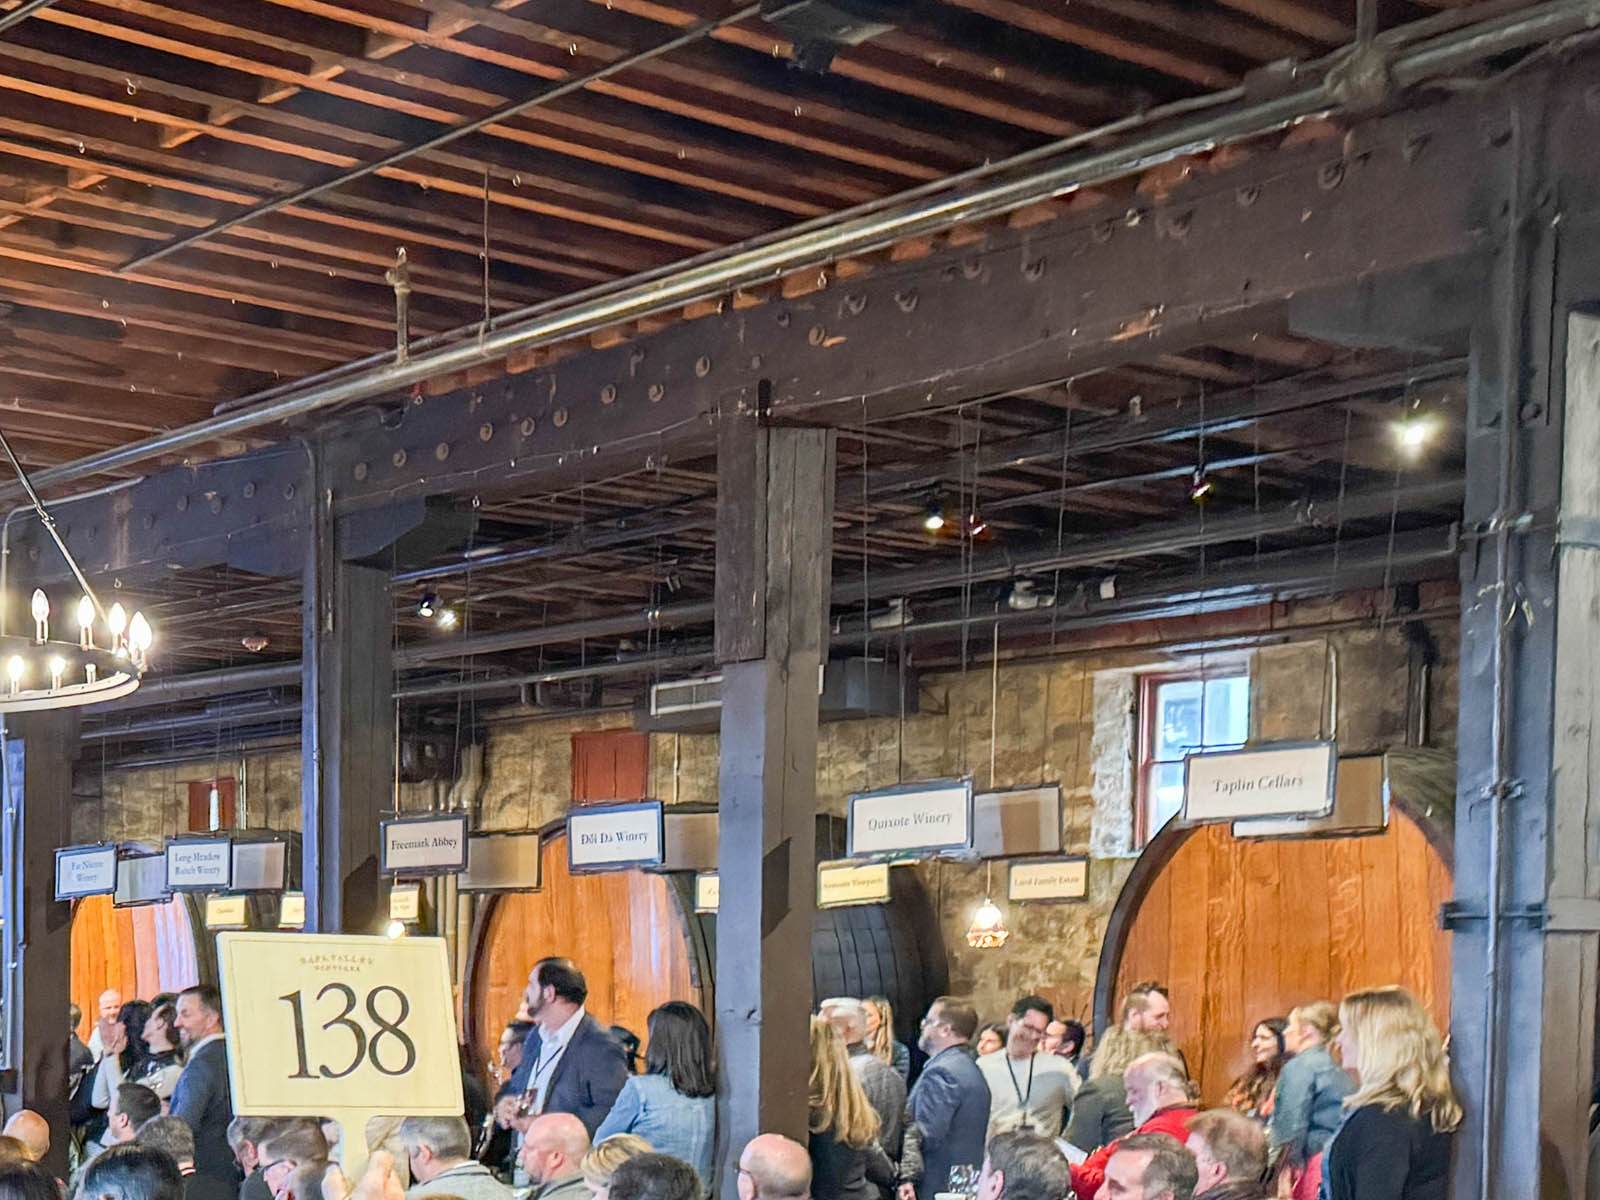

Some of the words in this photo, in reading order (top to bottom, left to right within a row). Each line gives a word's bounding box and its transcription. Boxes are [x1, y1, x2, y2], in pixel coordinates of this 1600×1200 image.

[1212, 778, 1255, 797] Taplin
[1257, 774, 1304, 790] Cellars
[868, 816, 911, 832] Quixote
[913, 811, 952, 825] Winery
[391, 838, 431, 851] Freemark
[432, 837, 457, 849] Abbey
[615, 830, 649, 845] Winery
[279, 982, 417, 1080] 138
